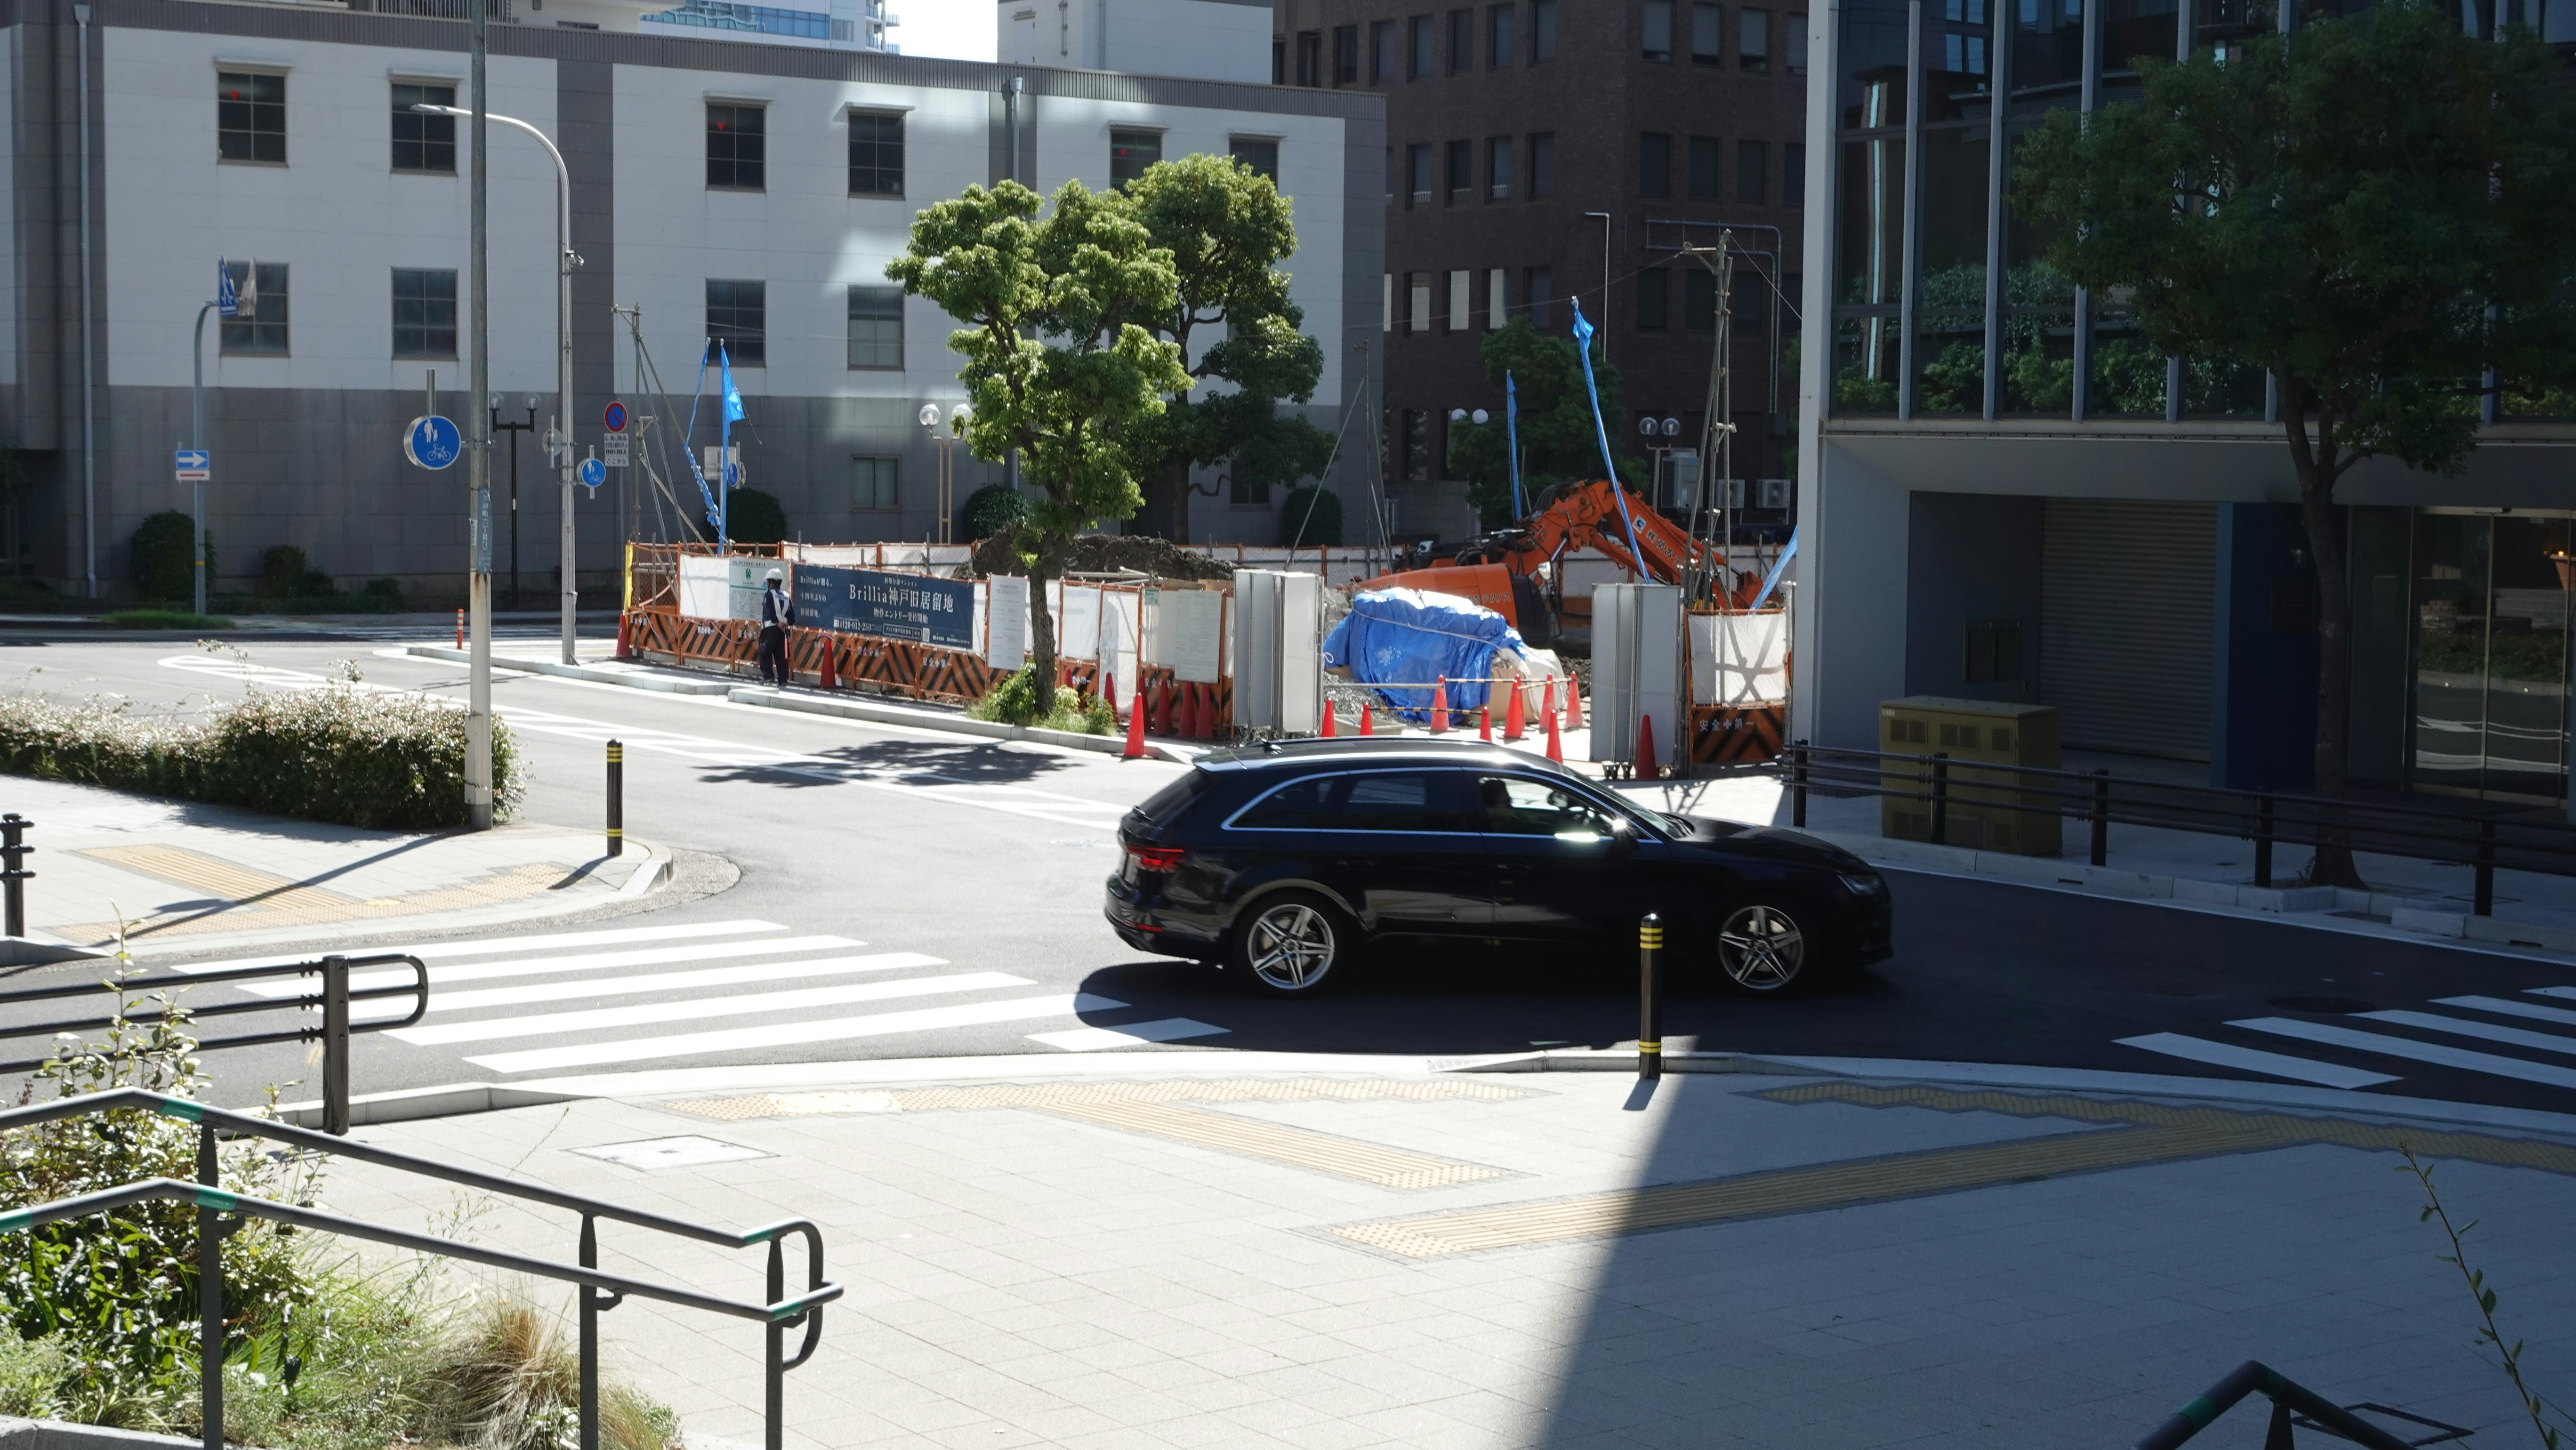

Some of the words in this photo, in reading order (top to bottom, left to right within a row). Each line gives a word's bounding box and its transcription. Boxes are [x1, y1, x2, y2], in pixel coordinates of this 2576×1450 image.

[849, 583, 953, 612] Brillia神戸旧居留地
[630, 615, 647, 626] 安全第
[874, 607, 928, 624] 物件エントリー受付開始
[923, 657, 951, 669] 安全第一
[1699, 717, 1754, 731] 安全第一
